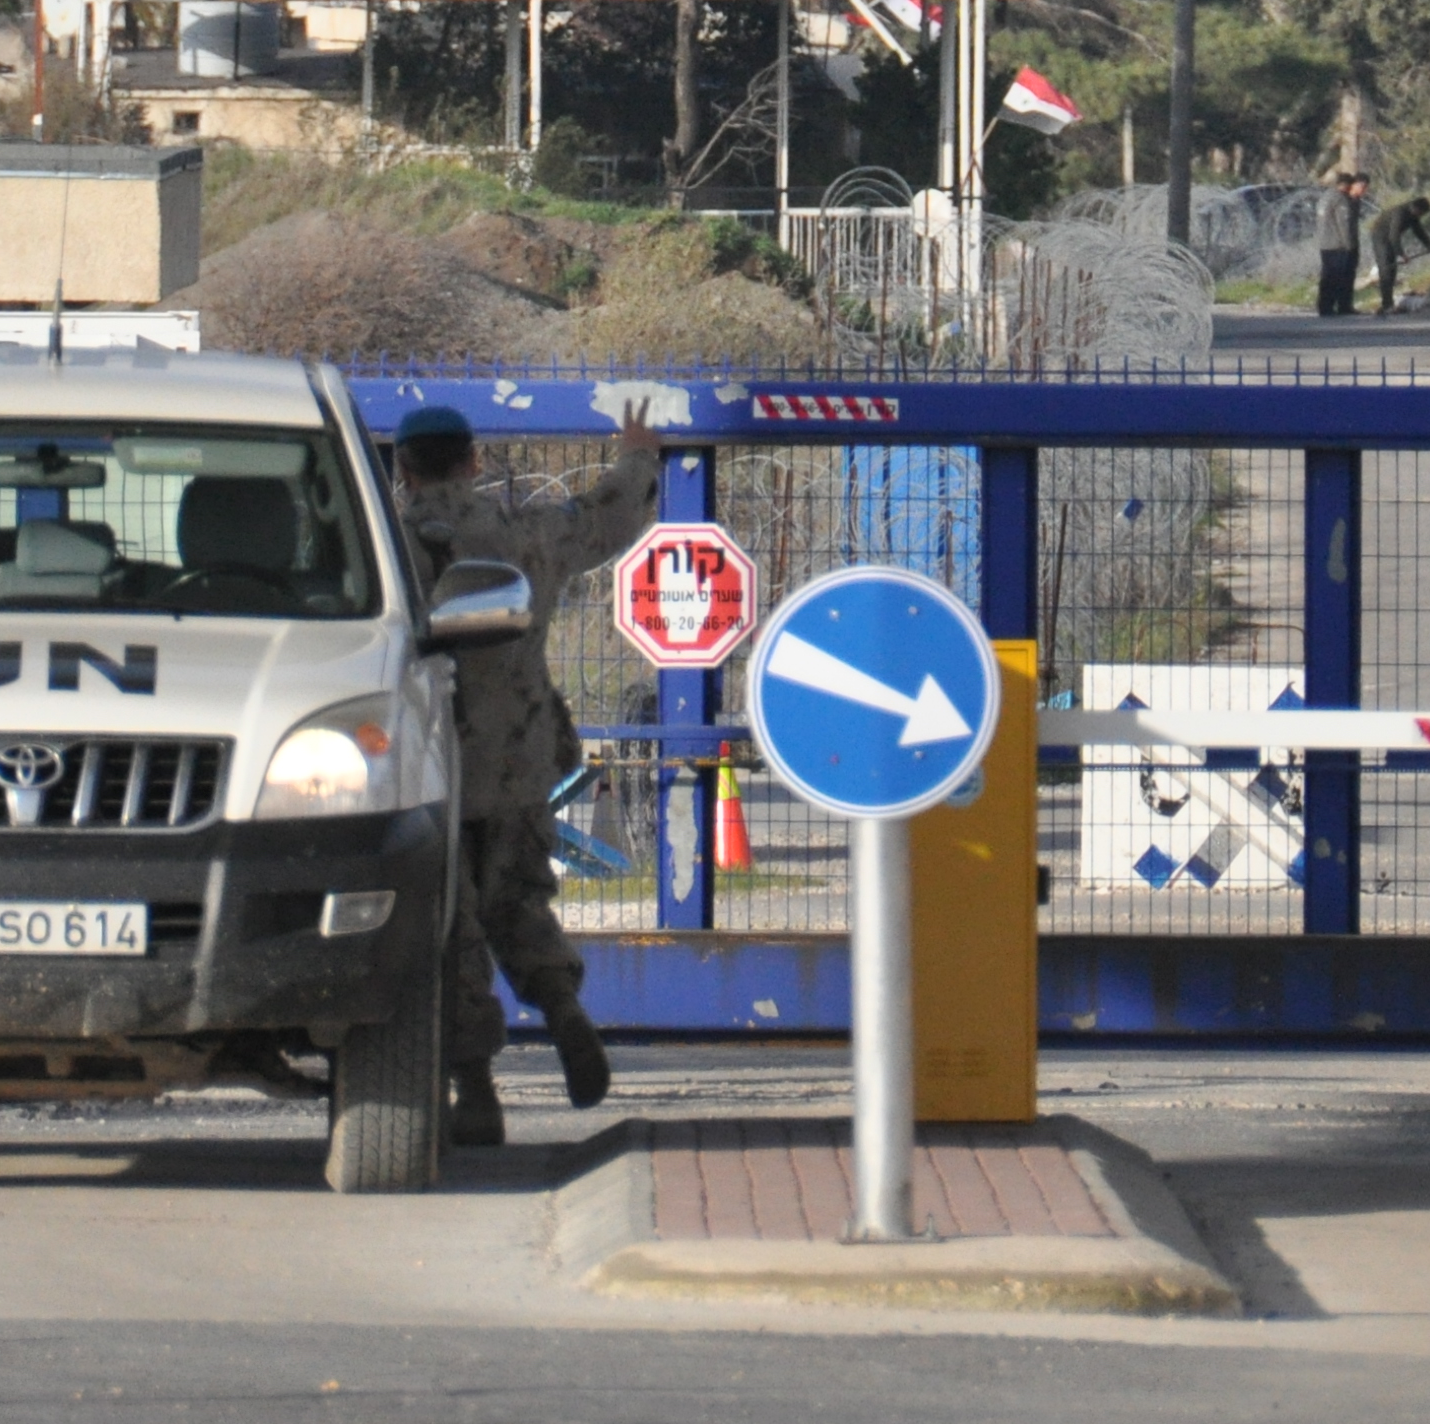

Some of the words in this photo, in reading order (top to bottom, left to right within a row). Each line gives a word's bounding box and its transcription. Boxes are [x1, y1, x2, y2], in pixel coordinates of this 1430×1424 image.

[630, 589, 695, 603] אוטומטיים
[698, 589, 744, 603] שערים
[631, 615, 745, 631] 1-800-20-66-20
[63, 910, 138, 948] 614
